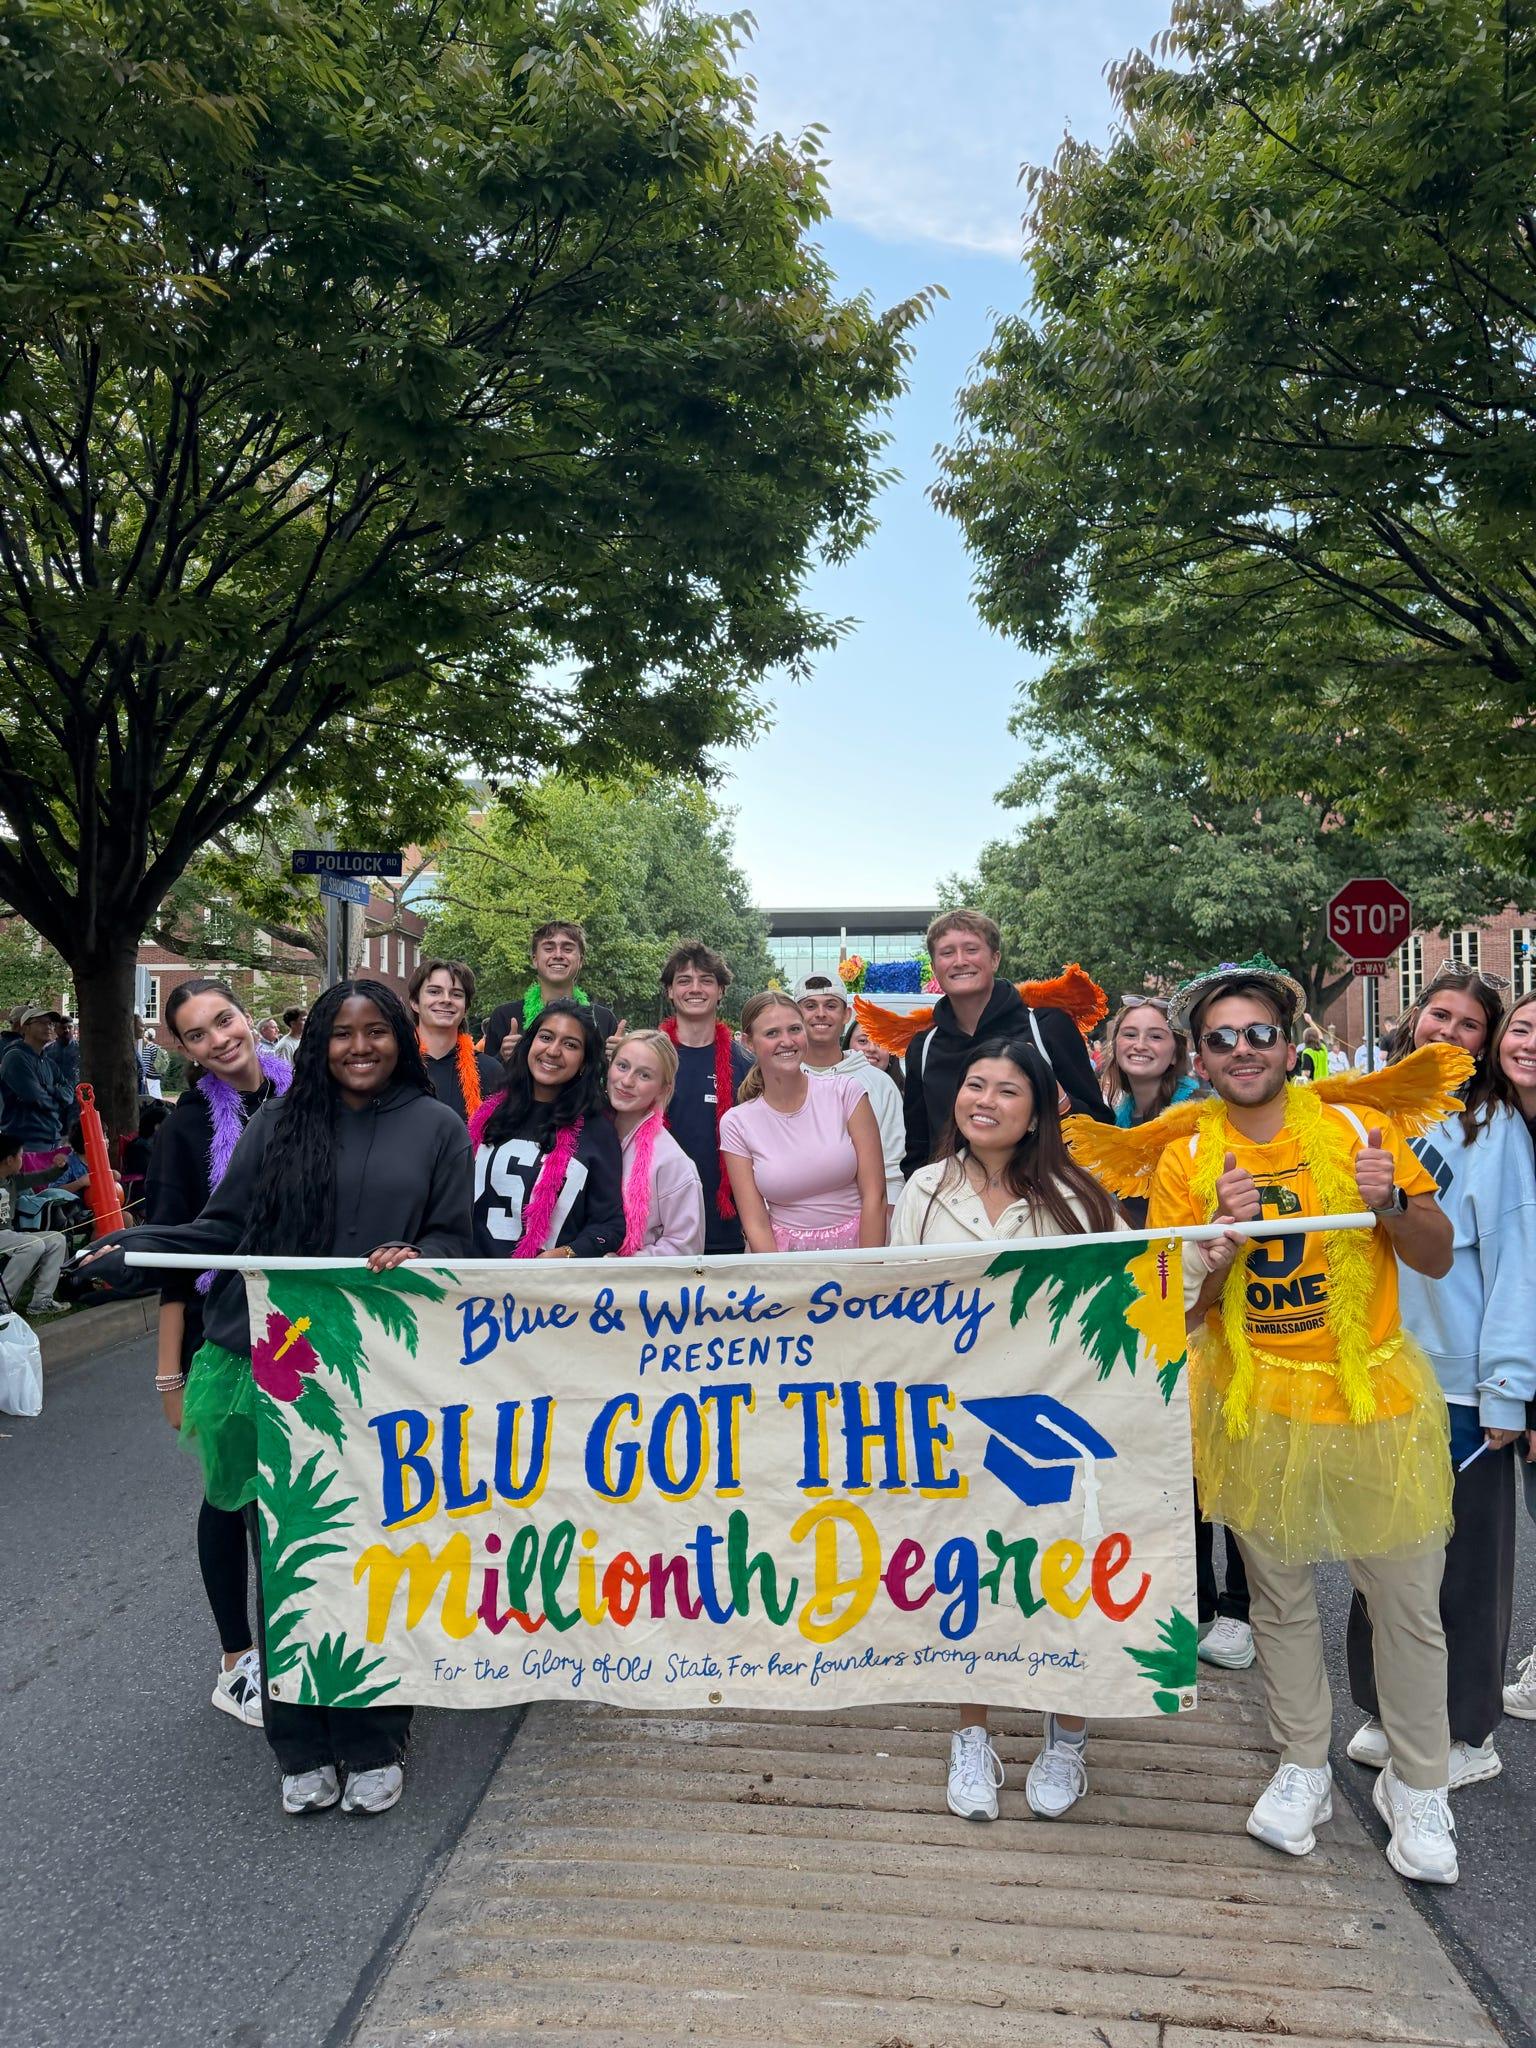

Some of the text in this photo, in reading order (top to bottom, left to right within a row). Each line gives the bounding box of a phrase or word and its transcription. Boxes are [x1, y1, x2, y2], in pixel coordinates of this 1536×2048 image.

[316, 855, 382, 871] POLLOCK
[1333, 904, 1406, 935] STOP
[1355, 963, 1385, 974] 3-WAY
[457, 1279, 996, 1366] Blue & White Society
[1255, 1317, 1326, 1335] AMBASSADORS
[639, 1334, 815, 1376] PRESENTS
[367, 1380, 970, 1533] BLU GOT THE
[788, 1498, 1153, 1645] Degree
[433, 1658, 467, 1681] For
[474, 1657, 509, 1680] the
[522, 1648, 586, 1687] Glory
[592, 1652, 617, 1684] of
[617, 1656, 652, 1682] Old
[665, 1653, 722, 1683] State,
[727, 1655, 764, 1677] For
[767, 1652, 807, 1676] her
[810, 1647, 910, 1686] founders
[913, 1644, 983, 1675] strong
[985, 1644, 1025, 1663] and
